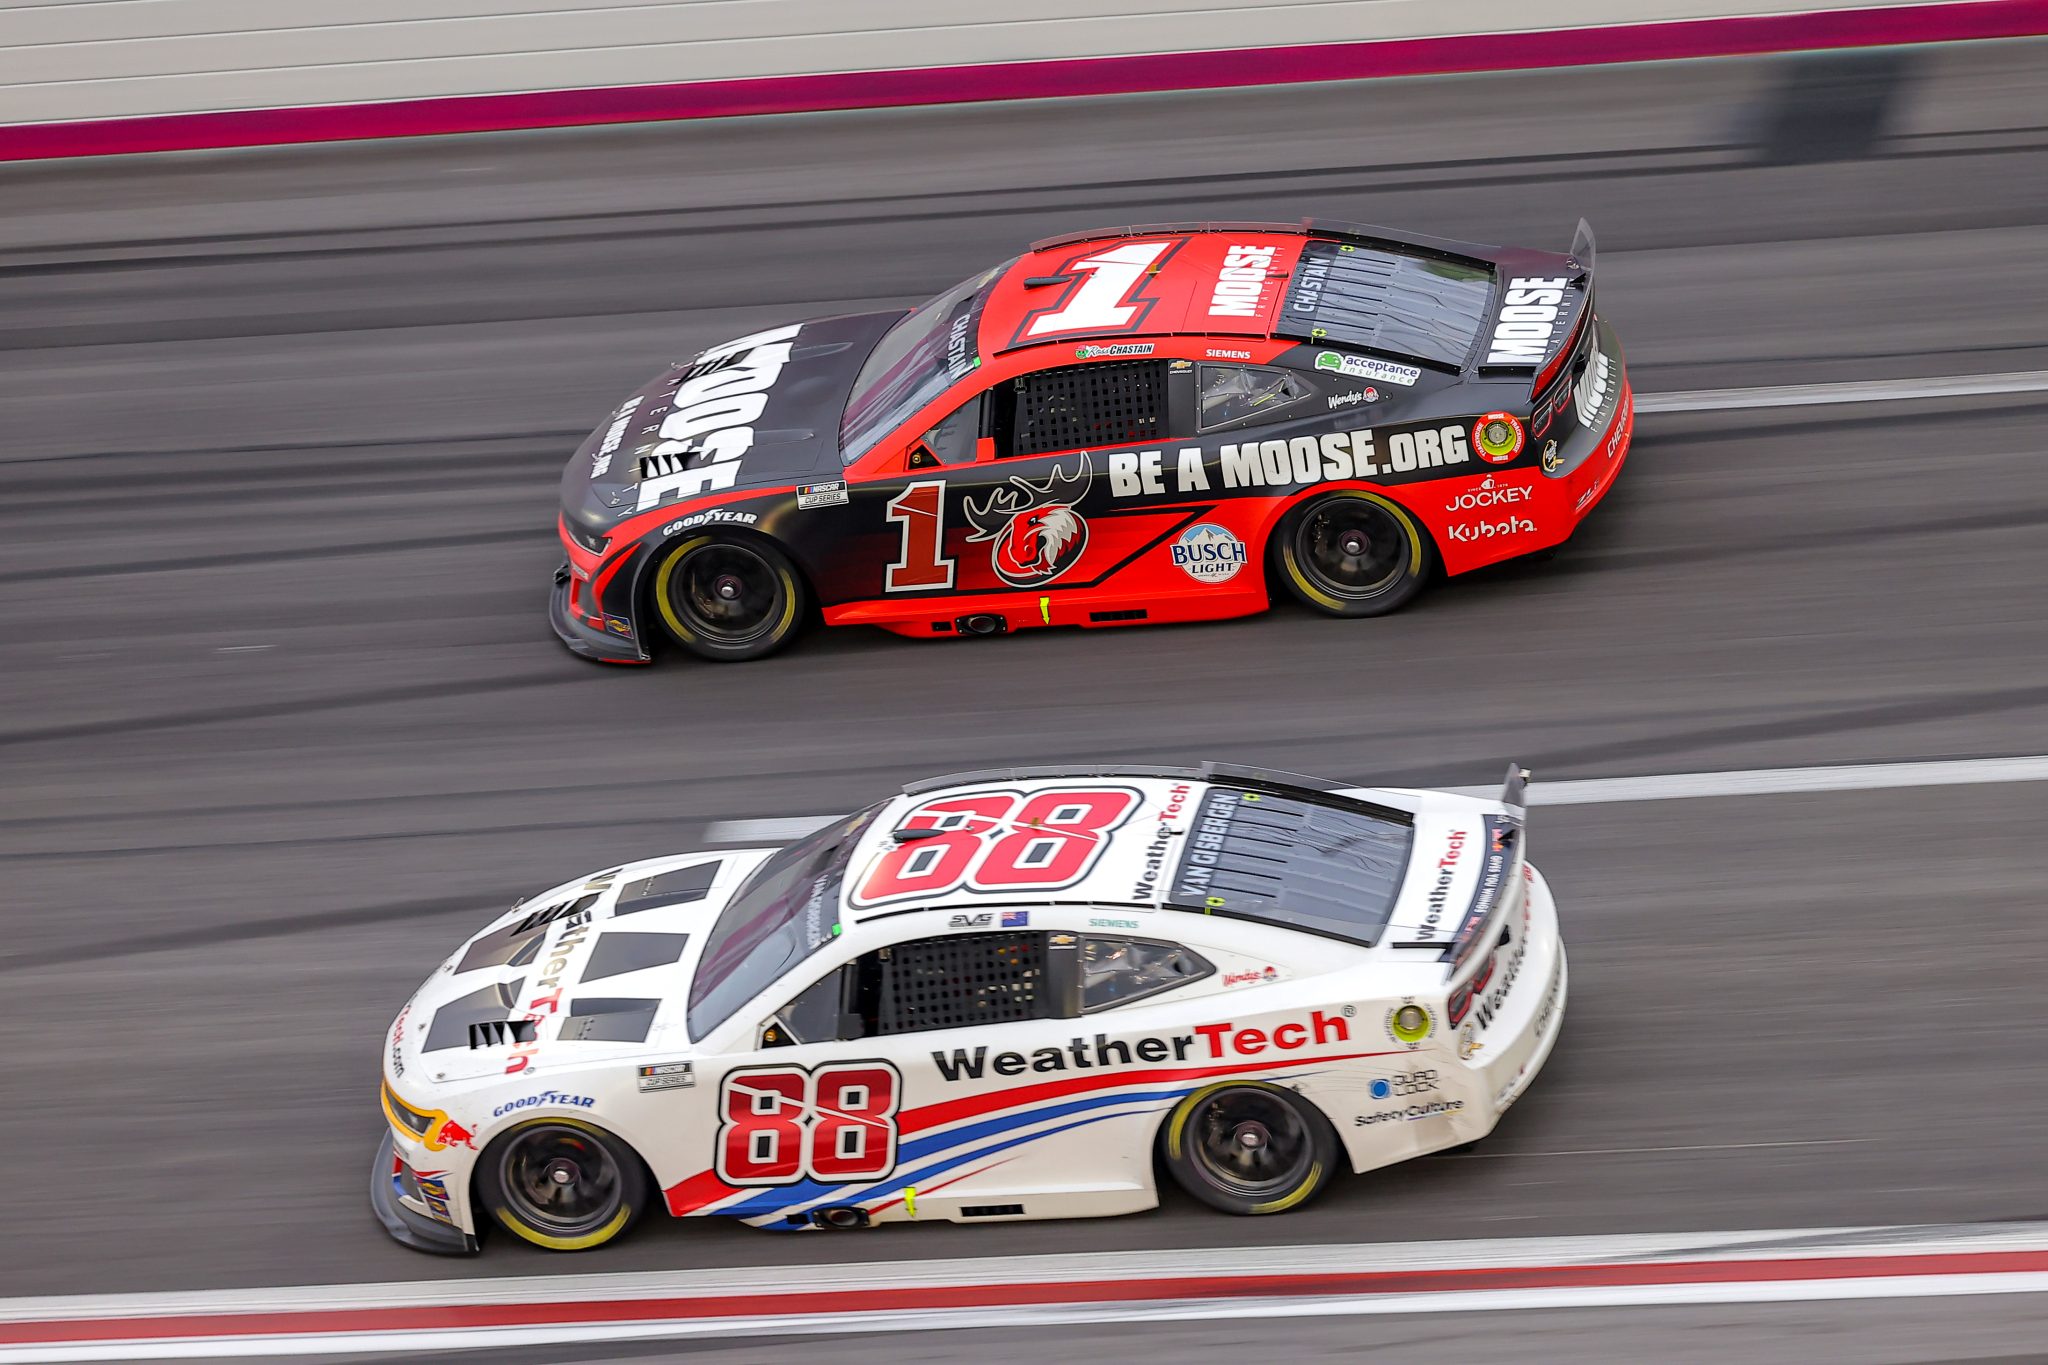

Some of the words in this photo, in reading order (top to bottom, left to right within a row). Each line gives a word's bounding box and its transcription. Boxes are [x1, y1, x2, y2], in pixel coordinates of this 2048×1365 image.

[1024, 240, 1173, 338] 1
[1208, 245, 1276, 317] MOOSE
[1293, 257, 1331, 313] CHASTAIN
[1486, 277, 1569, 364] MOOSE
[946, 313, 971, 380] CHASTAIN
[1109, 344, 1153, 355] CHASTAIN
[1205, 348, 1251, 359] SIEMENS
[1343, 365, 1413, 384] insurance
[1346, 356, 1418, 377] acceptance
[1327, 390, 1363, 410] Wendy's
[1108, 450, 1166, 498] BE
[1177, 447, 1211, 493] A
[1219, 424, 1470, 489] MOOSE.ORG
[804, 494, 818, 504] CUP
[819, 493, 841, 503] SERIES
[811, 482, 840, 493] NASCAR
[1445, 485, 1533, 512] JOCKEY
[662, 508, 758, 537] GOODYEAR
[884, 479, 956, 593] 1
[1447, 515, 1536, 542] Kubota
[1171, 542, 1247, 565] BUSCH
[1192, 562, 1234, 574] LIGHT
[1132, 784, 1192, 900] WeatherTech
[1190, 793, 1240, 866] GISBERGEN
[850, 786, 1144, 909] 88
[1179, 866, 1214, 896] VAN
[1416, 829, 1469, 941] WeatherTech
[1088, 918, 1140, 929] SIEMENS
[931, 1010, 1351, 1082] WeatherTech
[493, 1090, 596, 1117] GOODYEAR
[714, 1058, 901, 1188] 88
